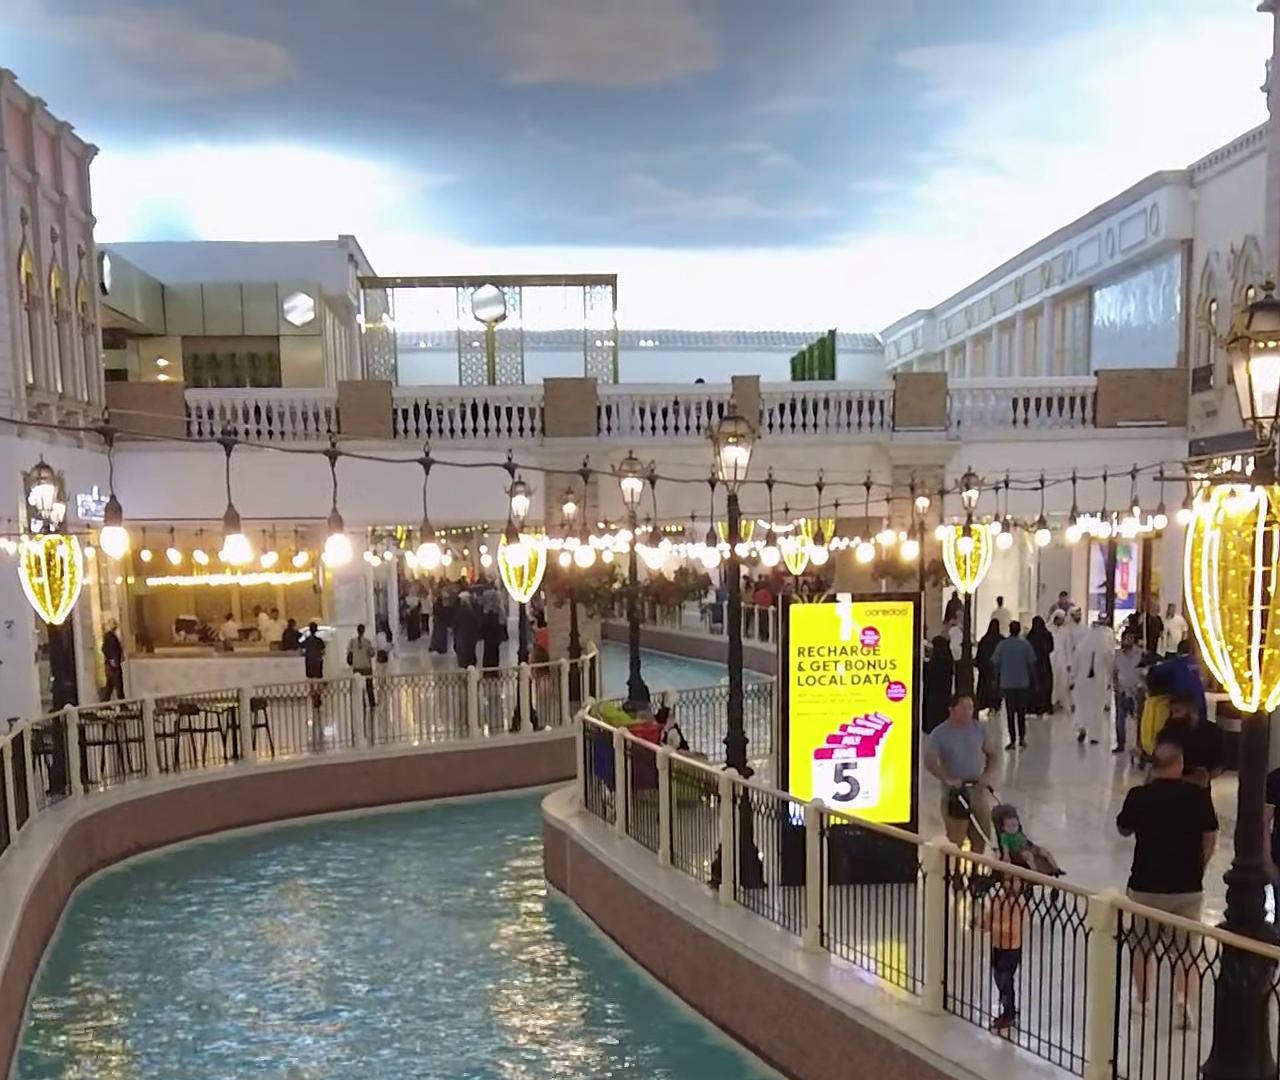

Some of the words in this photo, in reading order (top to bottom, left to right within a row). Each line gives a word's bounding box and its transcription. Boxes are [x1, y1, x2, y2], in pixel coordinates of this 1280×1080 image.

[797, 645, 881, 658] RECHARGE
[797, 661, 806, 672] &
[810, 660, 840, 672] GET
[845, 659, 897, 672] BONUS
[797, 674, 847, 687] LOCAL
[851, 673, 891, 686] DATA
[832, 762, 861, 802] 5
